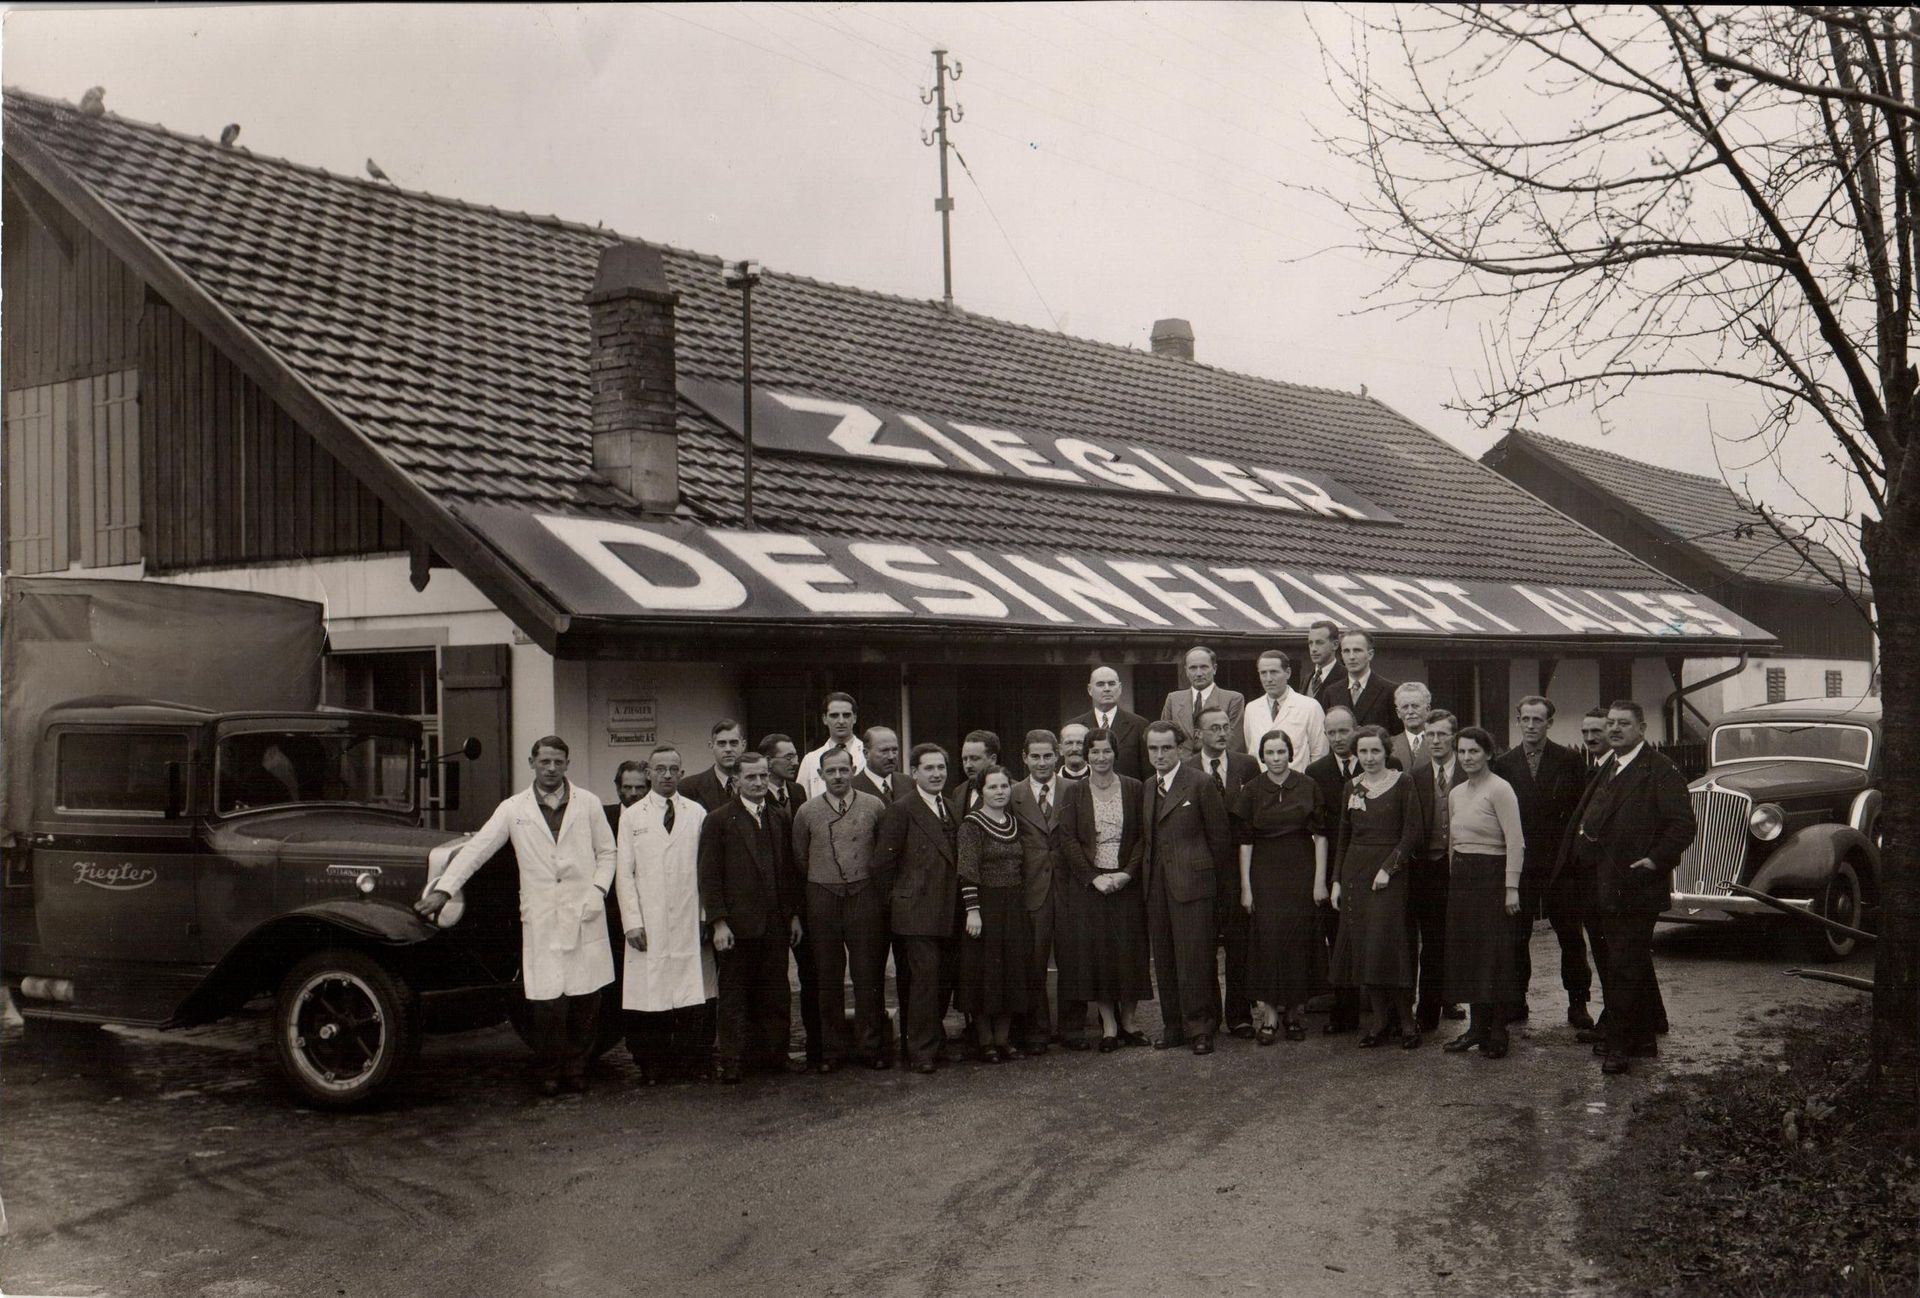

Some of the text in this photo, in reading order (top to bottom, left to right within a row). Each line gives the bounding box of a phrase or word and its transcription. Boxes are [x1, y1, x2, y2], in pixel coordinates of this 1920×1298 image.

[766, 392, 1369, 520] ZIEGLER
[533, 514, 1742, 636] DESINFIZIERT ALLES
[72, 861, 157, 890] Ziegler
